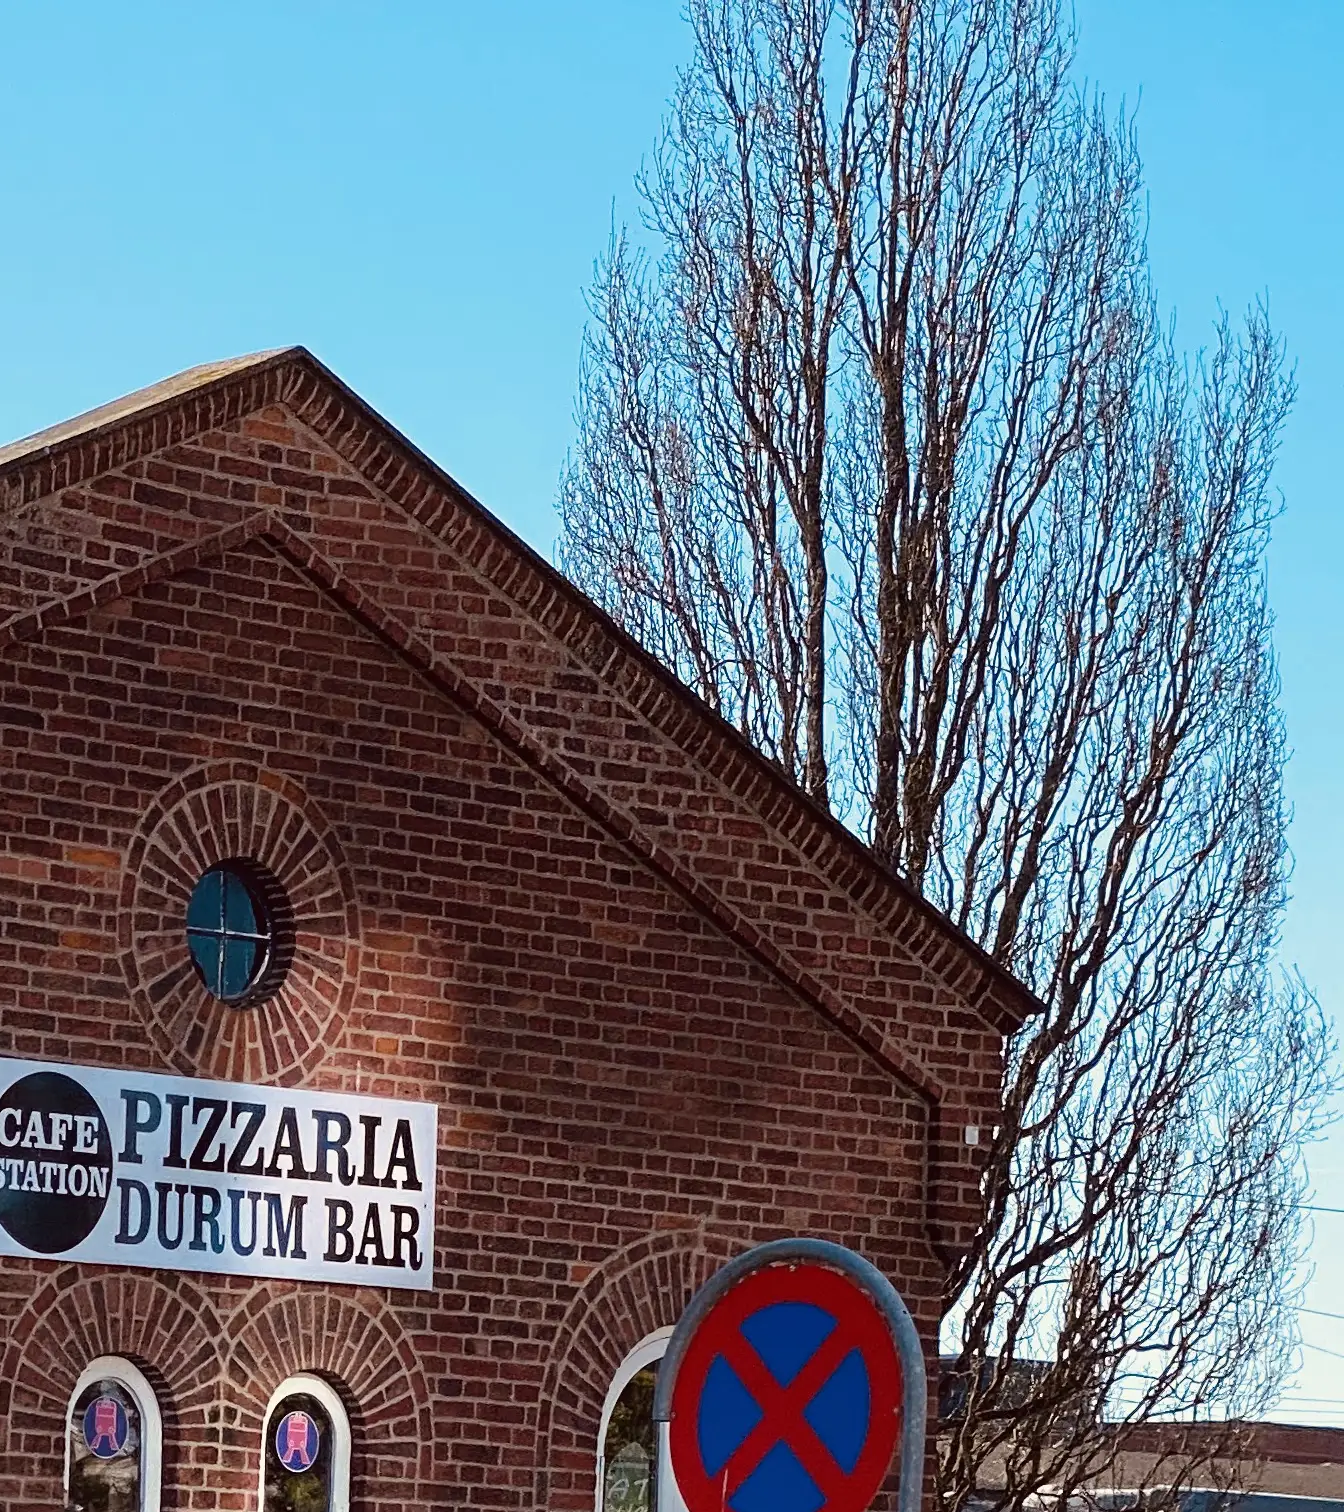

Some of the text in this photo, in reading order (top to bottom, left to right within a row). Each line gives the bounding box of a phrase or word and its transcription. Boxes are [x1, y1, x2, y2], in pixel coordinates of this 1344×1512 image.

[117, 1088, 423, 1192] PIZZARIA
[114, 1178, 424, 1272] DURUM BAR
